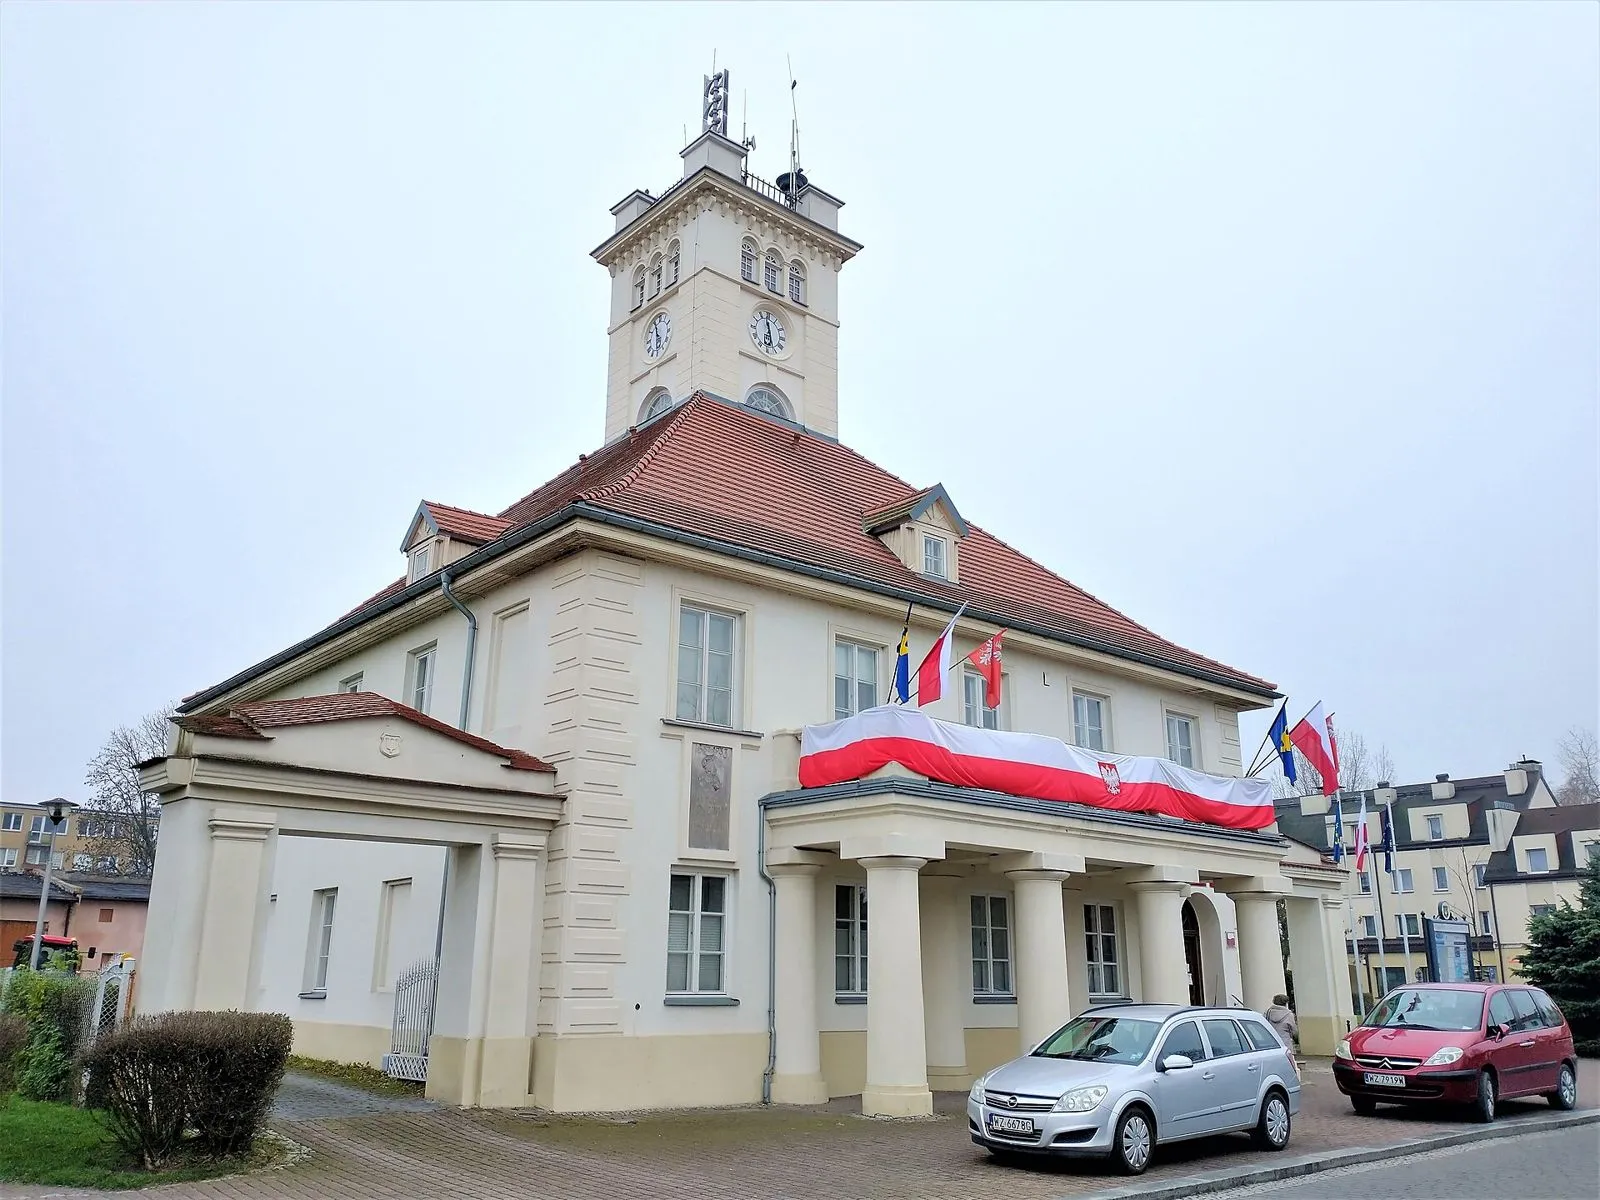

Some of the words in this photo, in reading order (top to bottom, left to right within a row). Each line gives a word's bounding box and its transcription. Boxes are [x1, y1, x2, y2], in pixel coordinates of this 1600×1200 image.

[1369, 1074, 1380, 1084] WZ
[1380, 1075, 1404, 1085] 7919W
[993, 1116, 1005, 1128] WZ
[1006, 1118, 1032, 1131] 6678G
